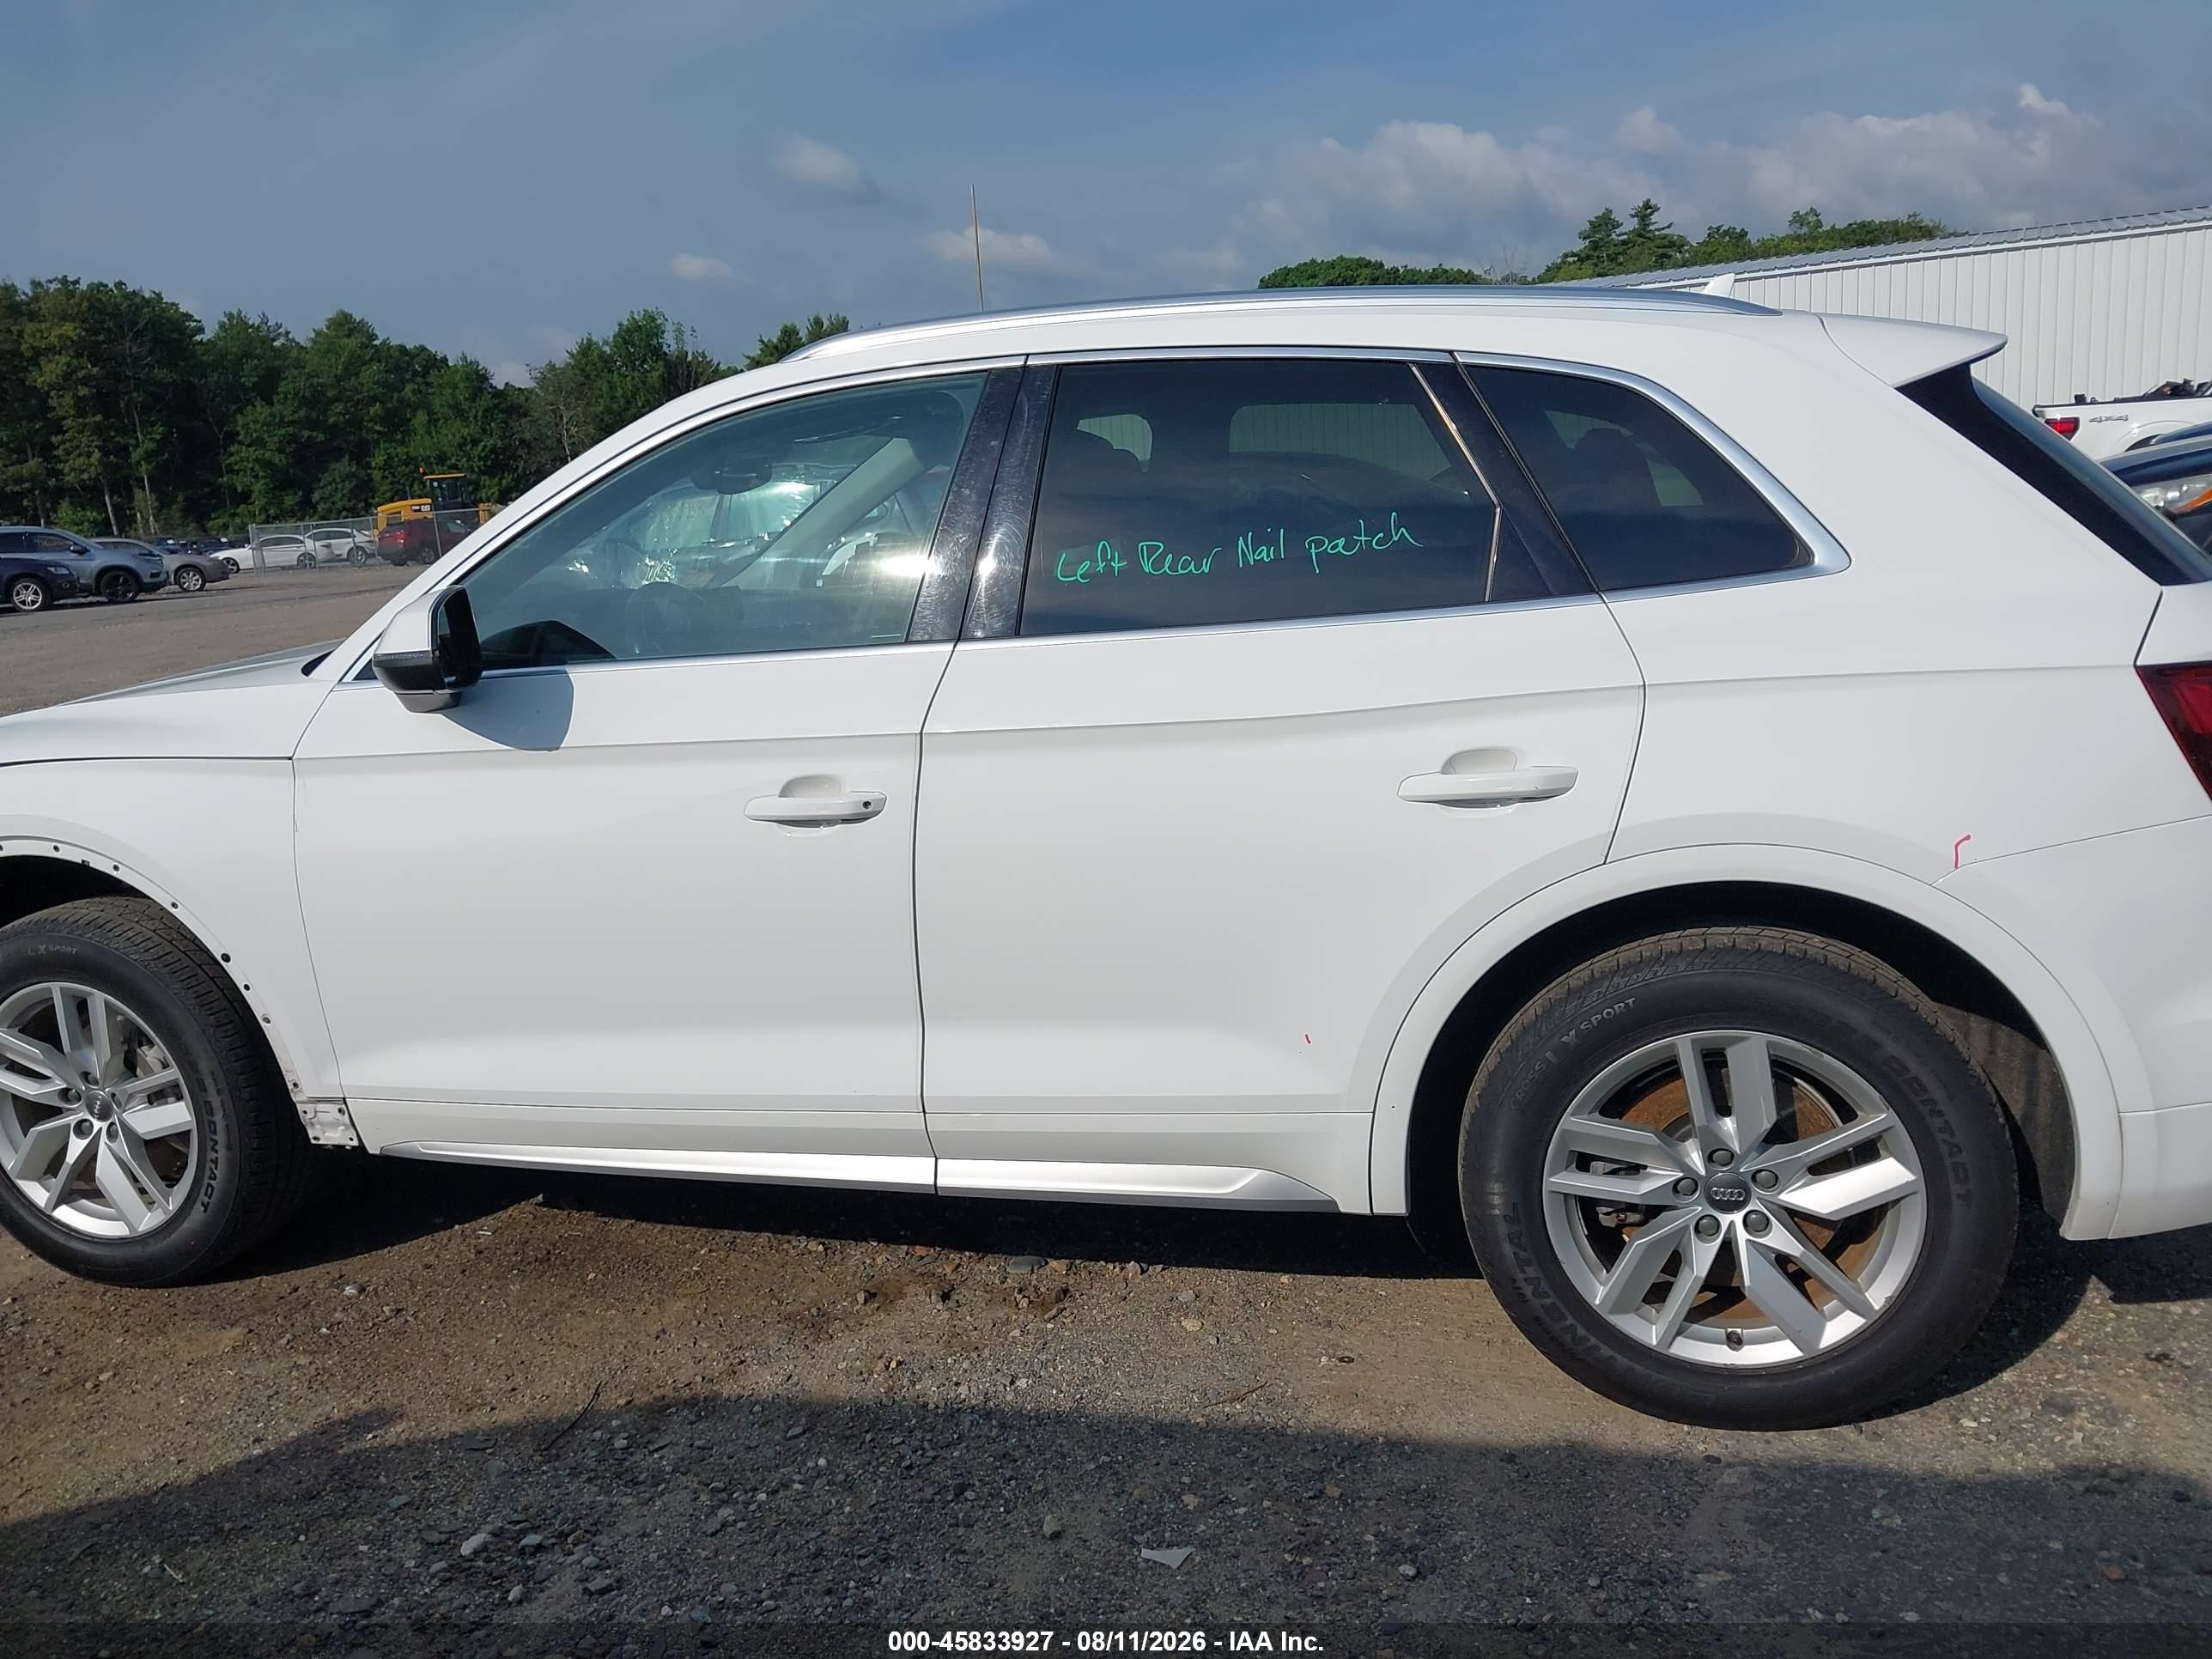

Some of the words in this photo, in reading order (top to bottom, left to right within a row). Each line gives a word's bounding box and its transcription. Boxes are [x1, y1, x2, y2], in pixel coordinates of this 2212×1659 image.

[1237, 527, 1285, 568] Nail
[1304, 512, 1424, 574] patch
[1579, 997, 1636, 1031] SPORT
